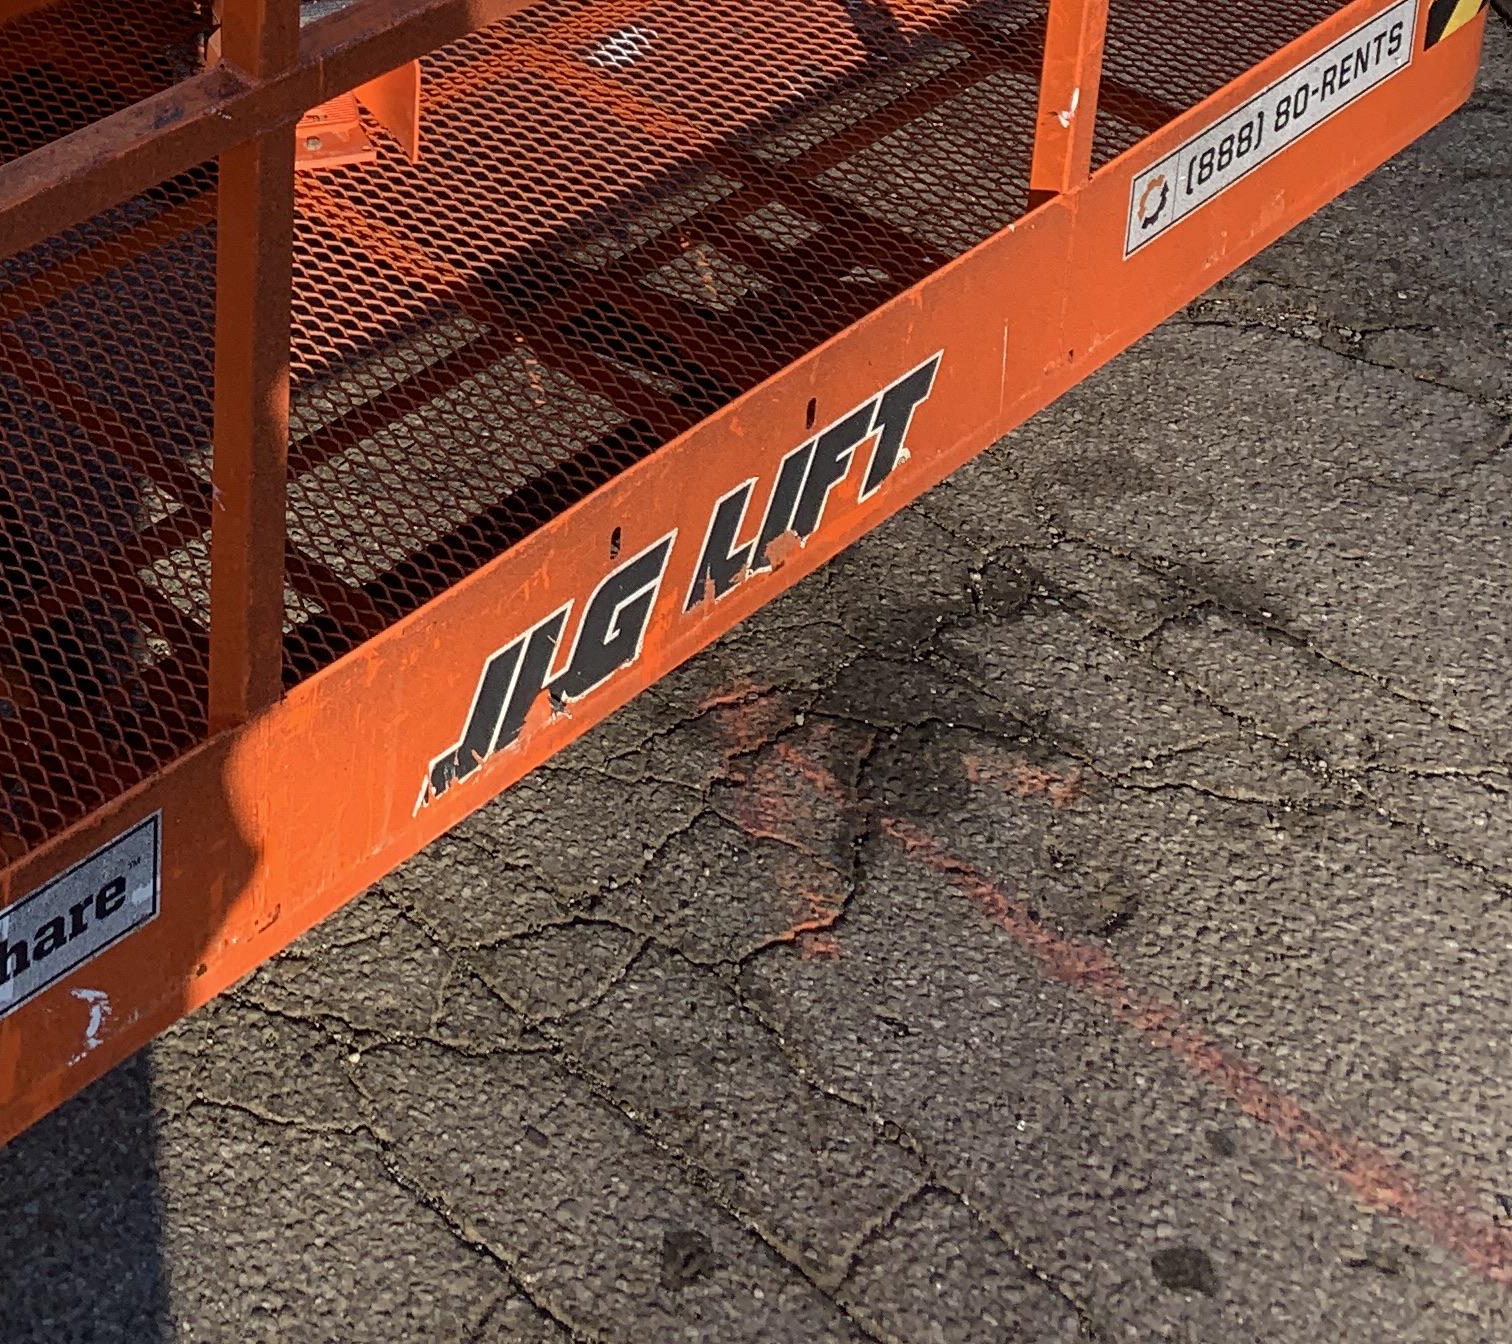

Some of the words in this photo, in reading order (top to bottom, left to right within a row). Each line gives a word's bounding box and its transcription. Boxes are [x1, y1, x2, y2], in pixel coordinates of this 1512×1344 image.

[1185, 111, 1264, 196] (888)
[1273, 20, 1404, 134] 80-RENTS
[414, 528, 678, 817] JLG
[681, 349, 945, 615] LIFT
